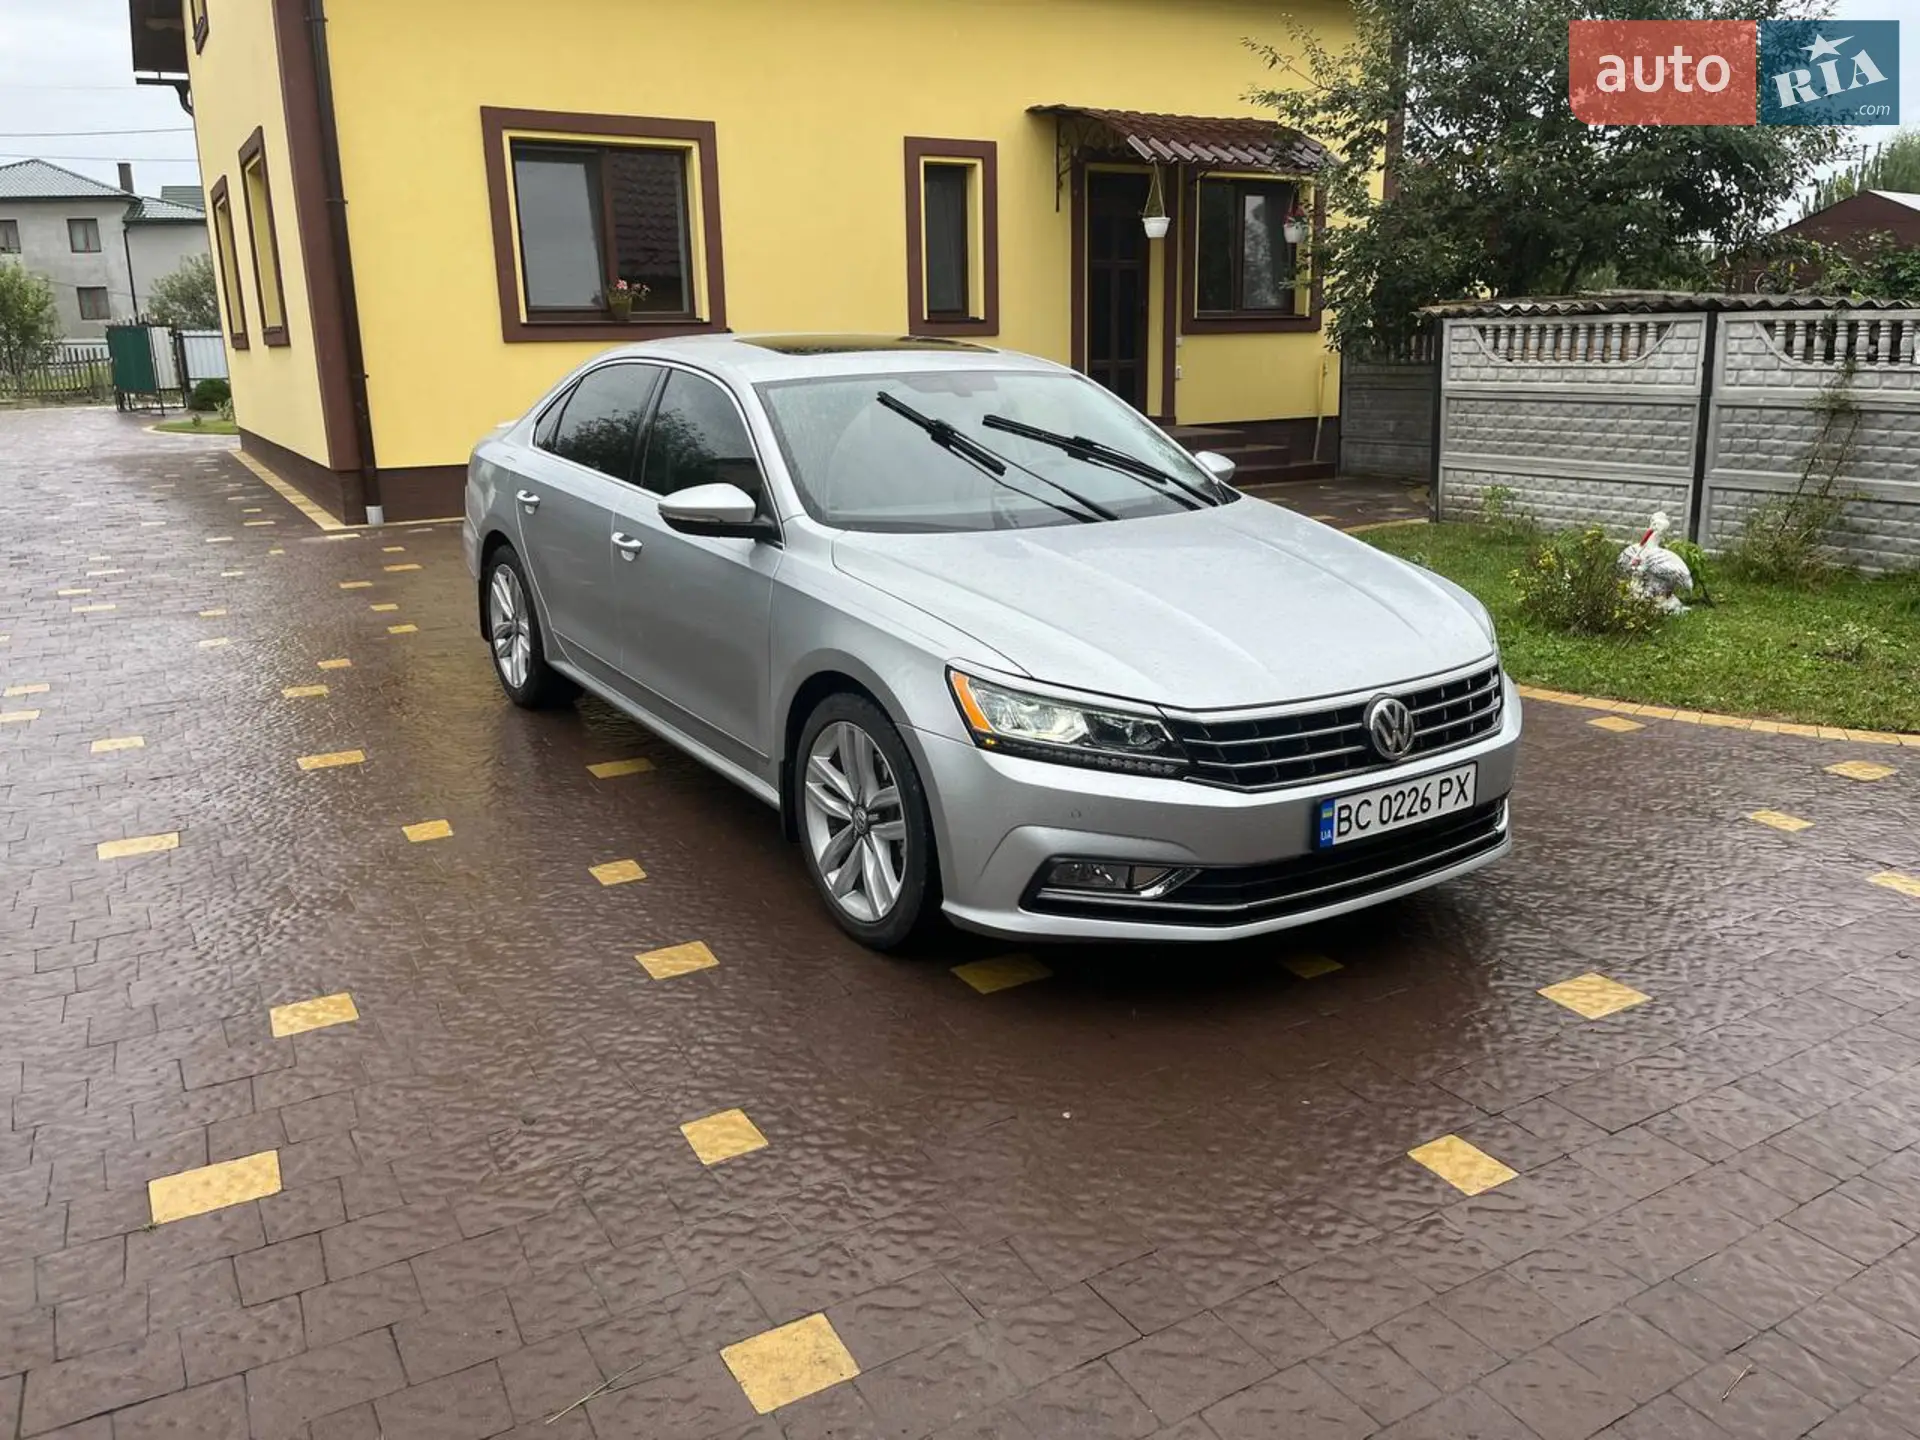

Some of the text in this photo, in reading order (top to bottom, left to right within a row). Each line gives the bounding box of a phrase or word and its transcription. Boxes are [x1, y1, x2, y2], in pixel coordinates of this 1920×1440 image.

[1336, 771, 1471, 837] BC 0226 PX
[1320, 830, 1332, 841] UA
